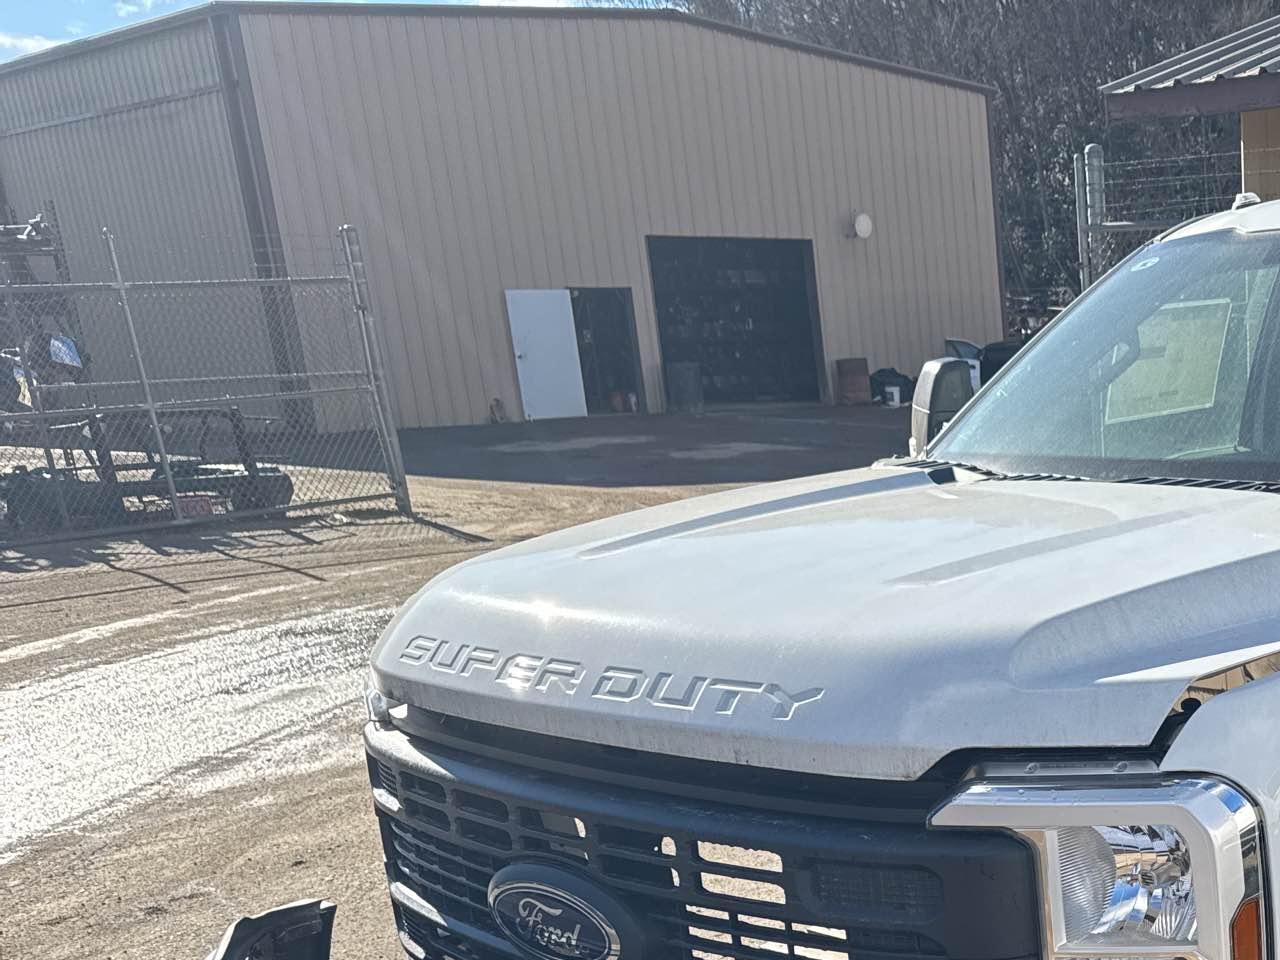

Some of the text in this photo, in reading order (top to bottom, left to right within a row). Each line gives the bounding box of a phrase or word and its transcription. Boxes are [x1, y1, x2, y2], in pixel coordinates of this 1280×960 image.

[400, 635, 826, 721] SUPER DUTY
[517, 897, 583, 949] Ford
